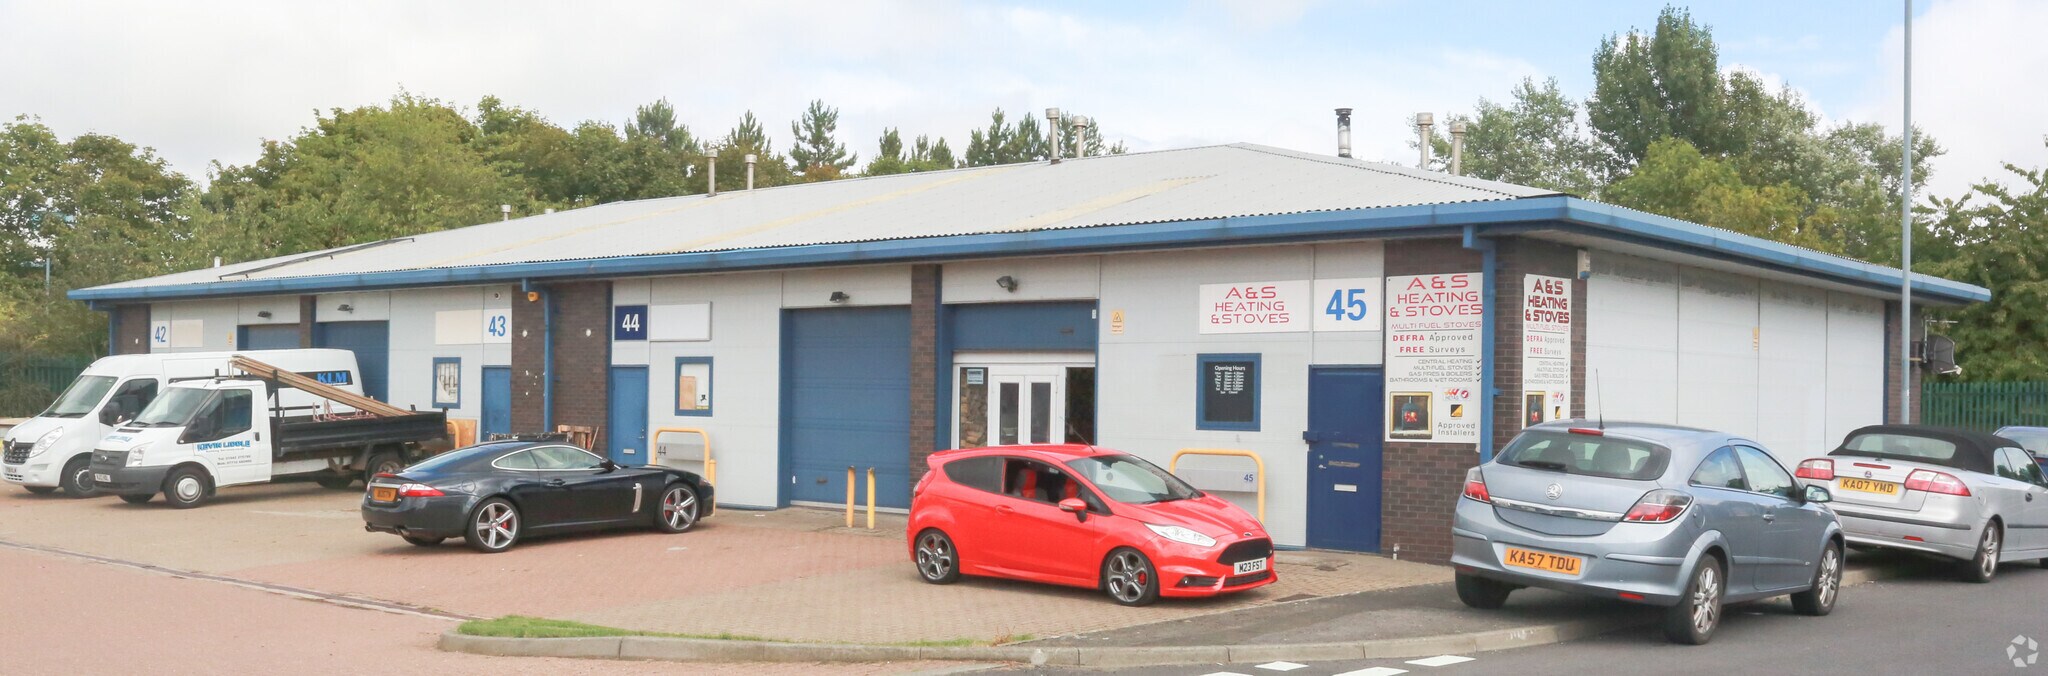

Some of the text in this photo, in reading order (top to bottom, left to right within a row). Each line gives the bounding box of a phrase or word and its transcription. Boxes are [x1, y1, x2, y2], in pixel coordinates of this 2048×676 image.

[1397, 291, 1478, 304] HEATING
[1528, 295, 1567, 310] HEATING
[1215, 301, 1285, 312] HEATING
[1325, 289, 1367, 321] 45
[1389, 304, 1483, 318] & STOVES
[622, 313, 640, 332] 44
[1533, 309, 1570, 324] STOVES
[488, 315, 506, 337] 43
[154, 326, 167, 343] 42
[1392, 334, 1473, 343] DEFRA Approved
[1428, 346, 1466, 354] Surveys
[1529, 347, 1543, 355] FREE
[317, 372, 347, 384] KLM
[1437, 422, 1475, 430] Approved
[657, 445, 667, 456] 44
[1243, 473, 1254, 482] 45
[1842, 479, 1894, 493] KA07 YMD
[1239, 560, 1263, 572] M23 FST
[1509, 550, 1575, 571] KA57 TDU
